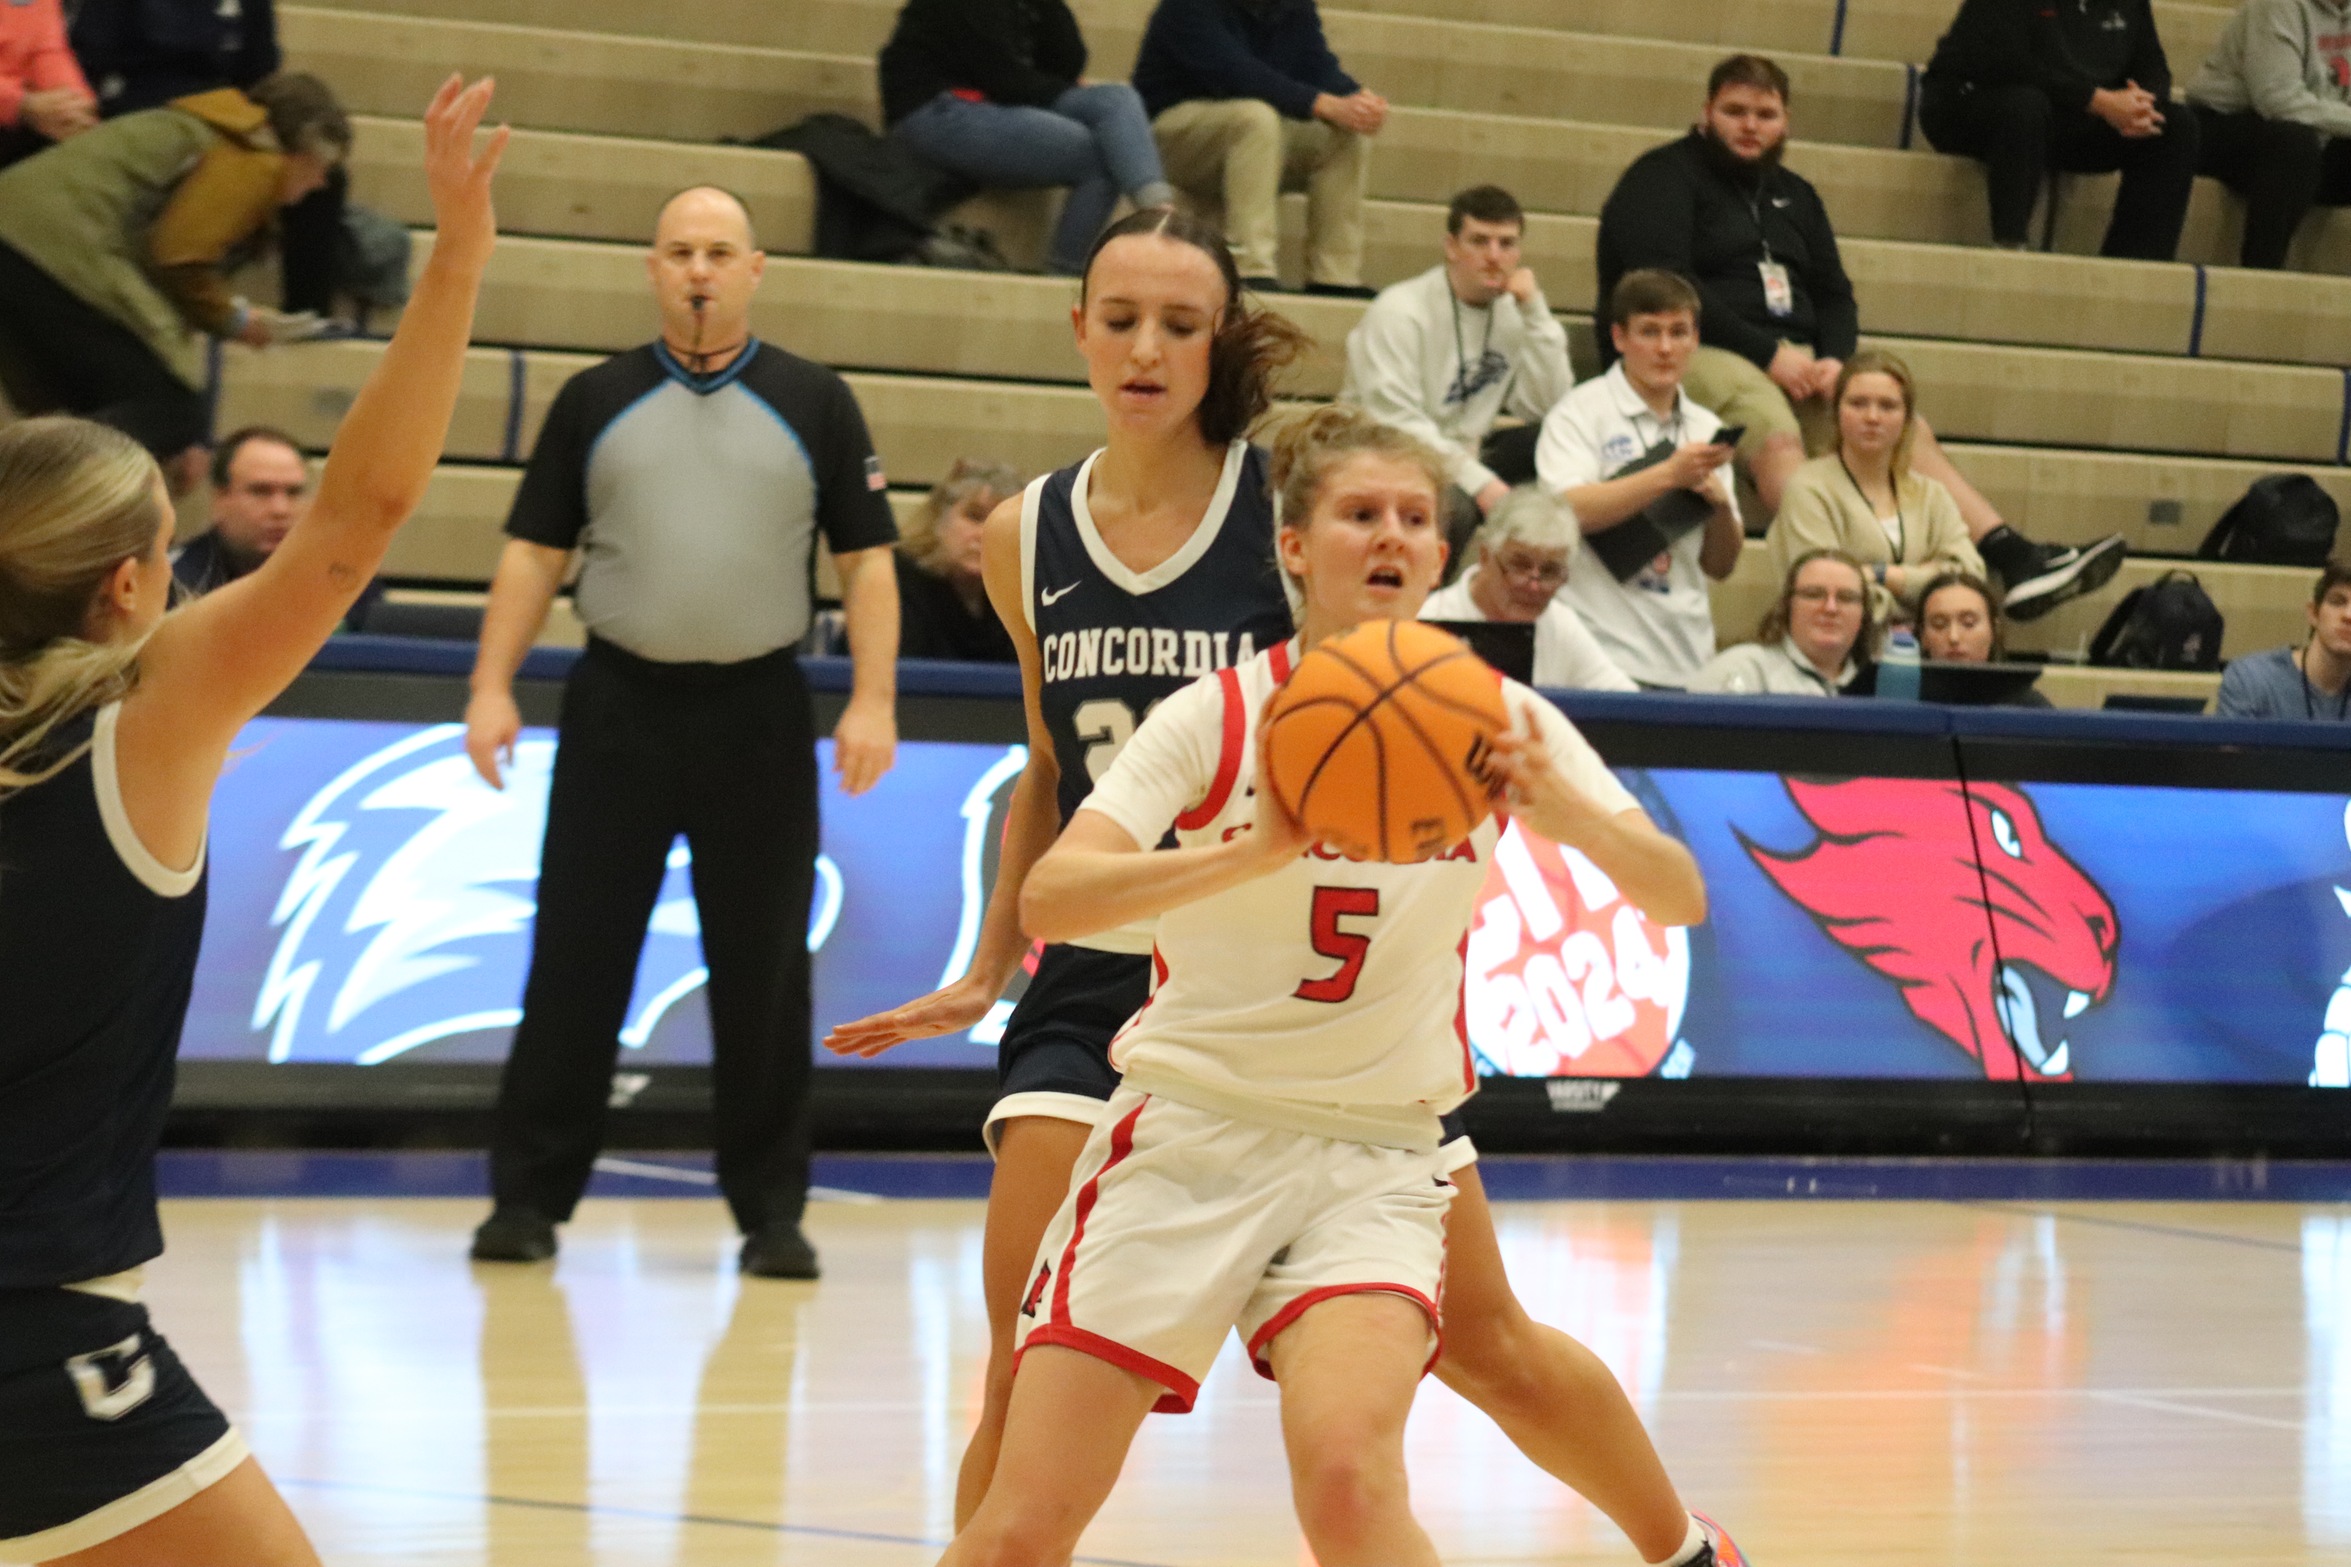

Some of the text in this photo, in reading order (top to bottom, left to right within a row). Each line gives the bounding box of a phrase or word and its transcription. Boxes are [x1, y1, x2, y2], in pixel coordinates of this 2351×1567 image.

[1043, 627, 1257, 683] CONCORDIA
[1290, 885, 1380, 1003] 5
[1482, 904, 1670, 1077] 2024
